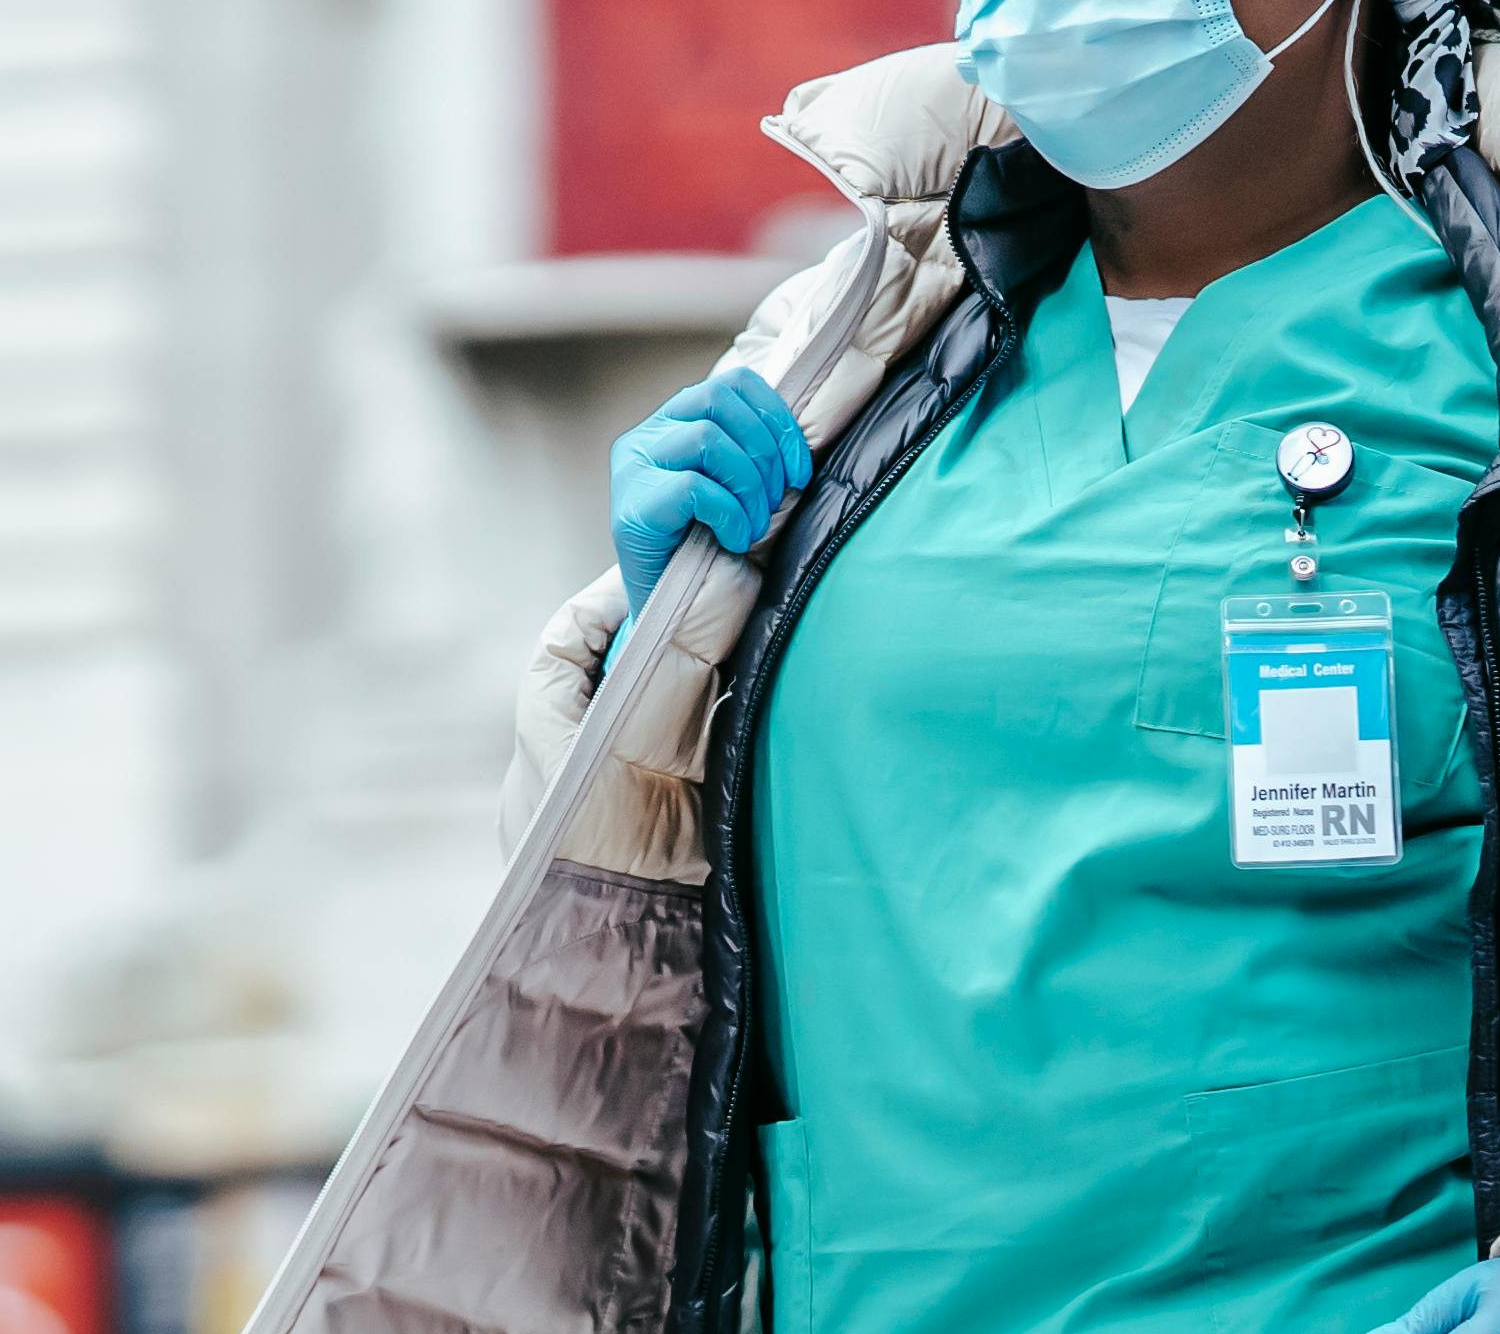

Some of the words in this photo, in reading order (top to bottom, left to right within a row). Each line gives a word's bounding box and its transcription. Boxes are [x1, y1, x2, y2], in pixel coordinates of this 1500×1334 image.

[1259, 664, 1307, 679] Medical
[1313, 663, 1355, 677] Center
[1251, 783, 1317, 801] Jennifer
[1322, 781, 1377, 799] Martin
[1321, 803, 1377, 836] RN
